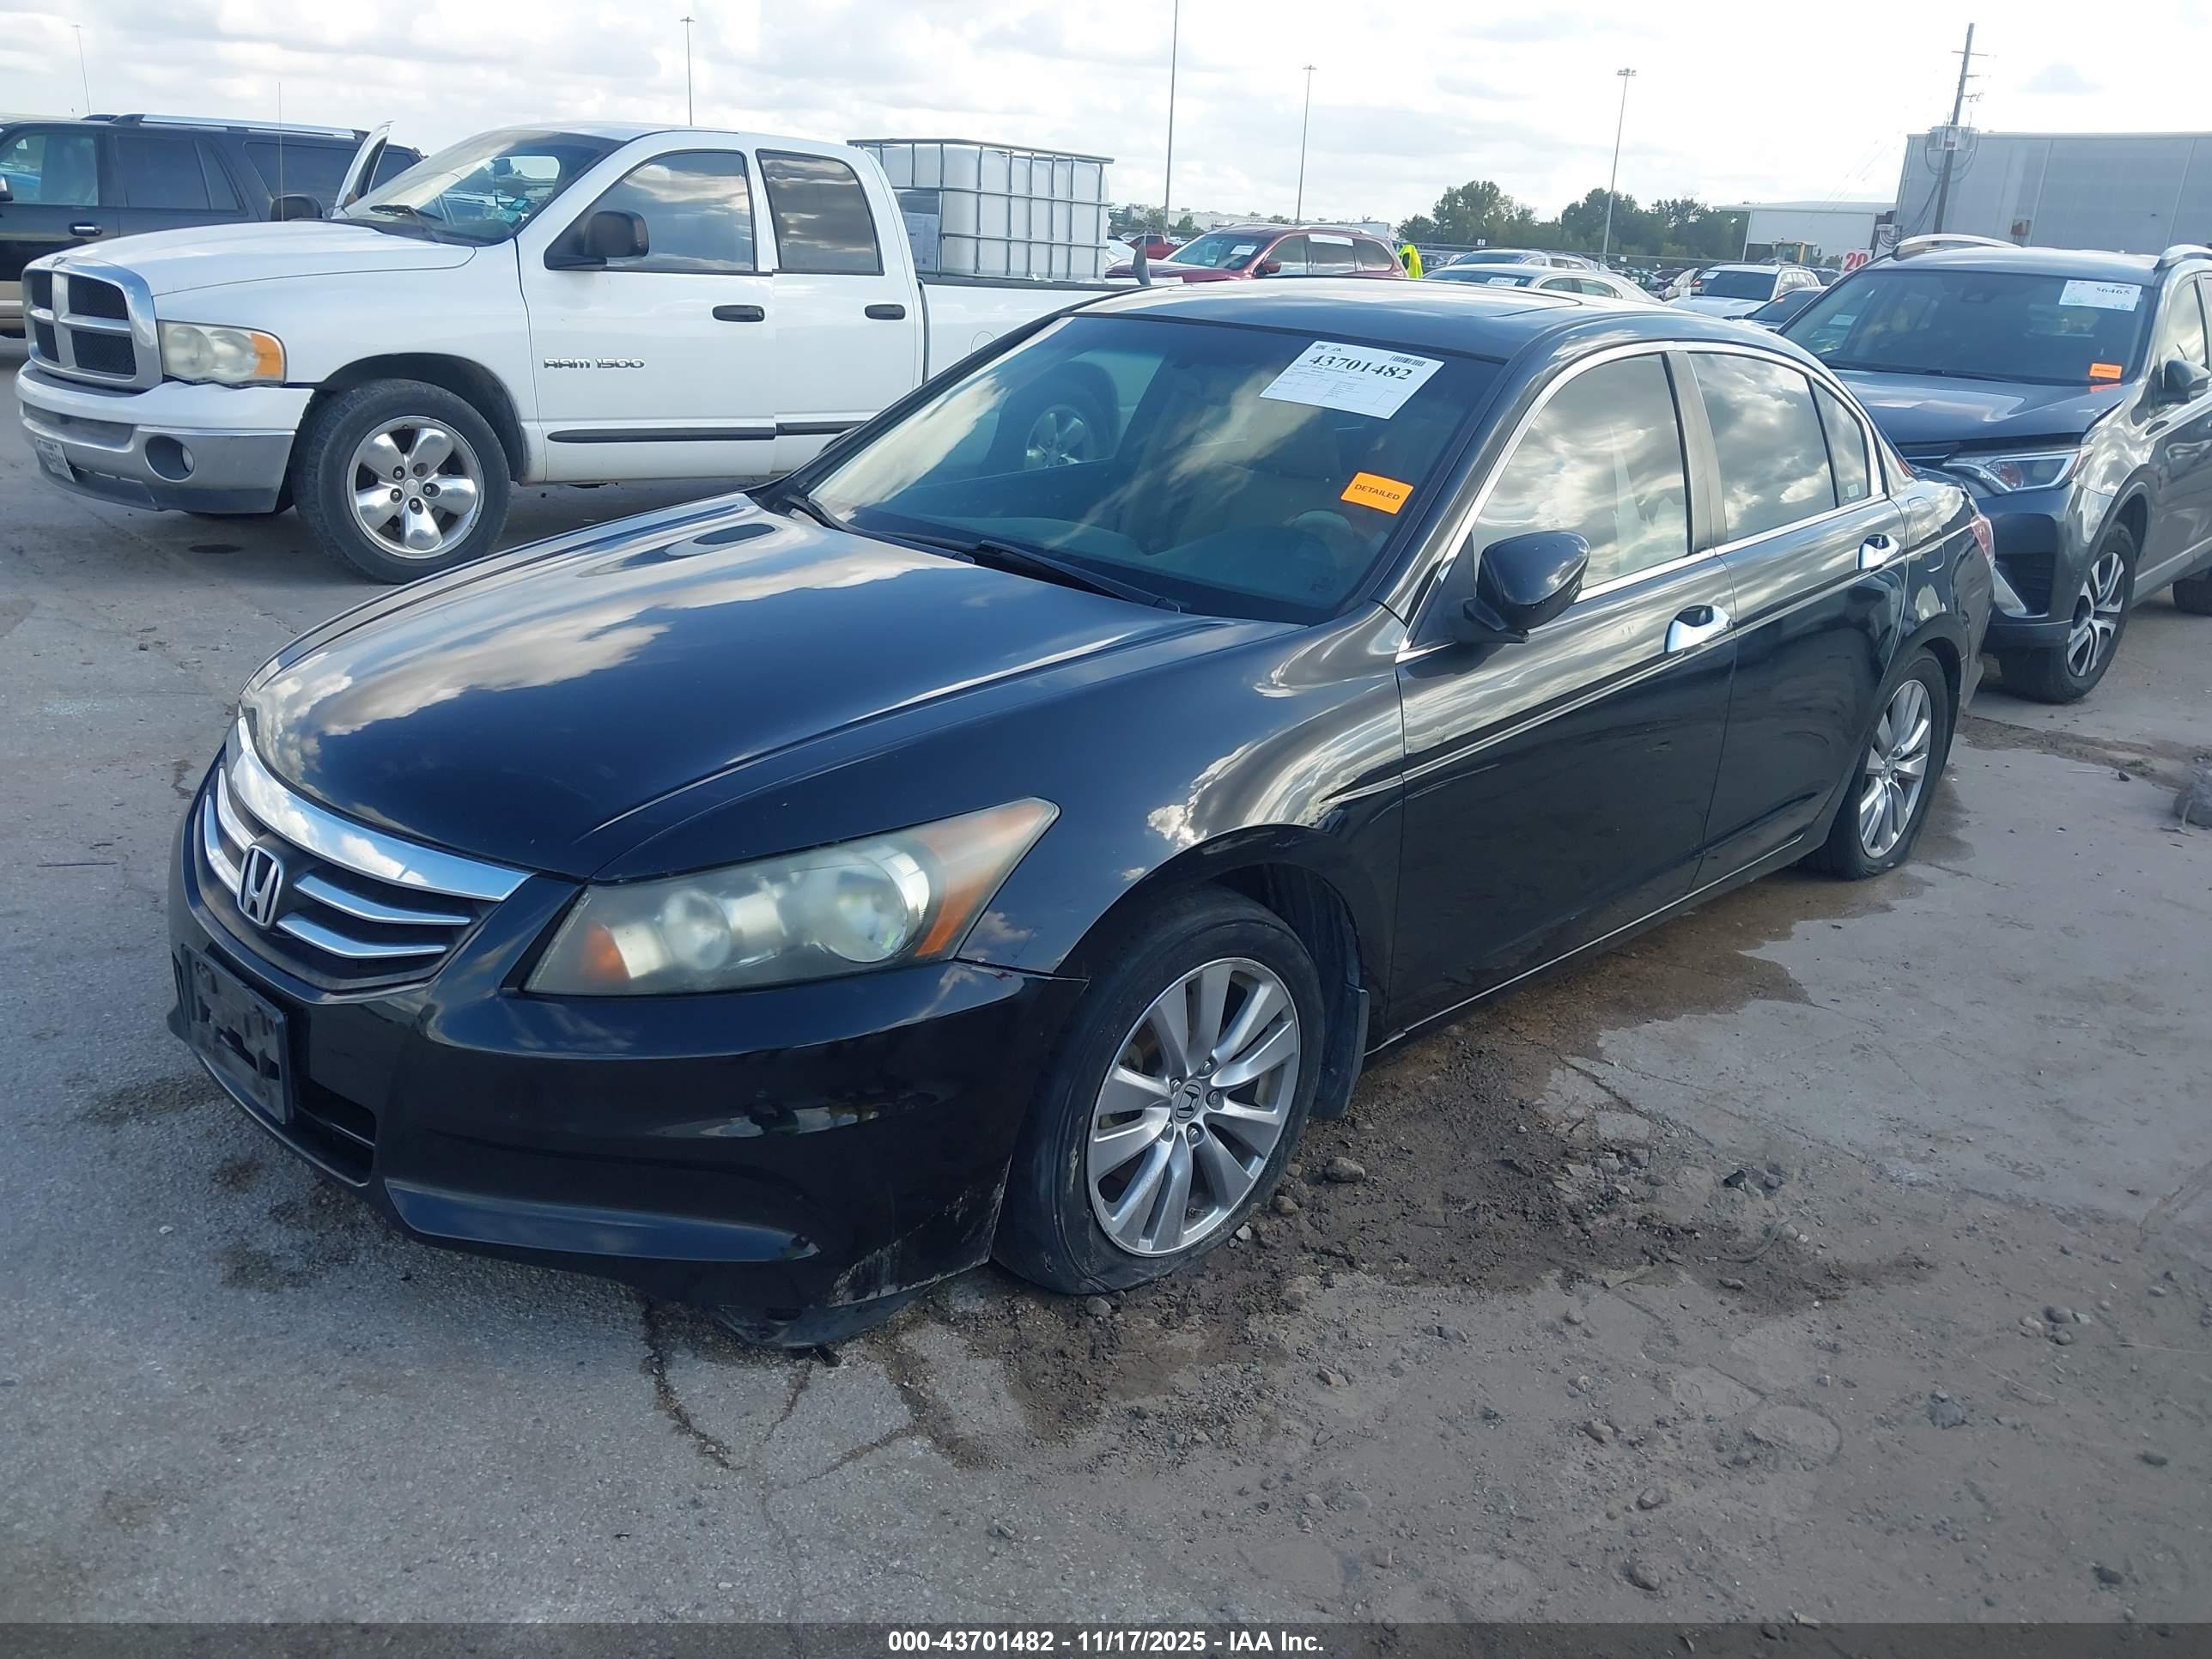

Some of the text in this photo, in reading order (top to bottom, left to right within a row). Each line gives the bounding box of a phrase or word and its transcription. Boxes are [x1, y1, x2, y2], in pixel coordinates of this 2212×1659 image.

[544, 358, 645, 368] RAM 1500
[1309, 355, 1413, 380] 43701482
[1354, 483, 1401, 501] DETAILED
